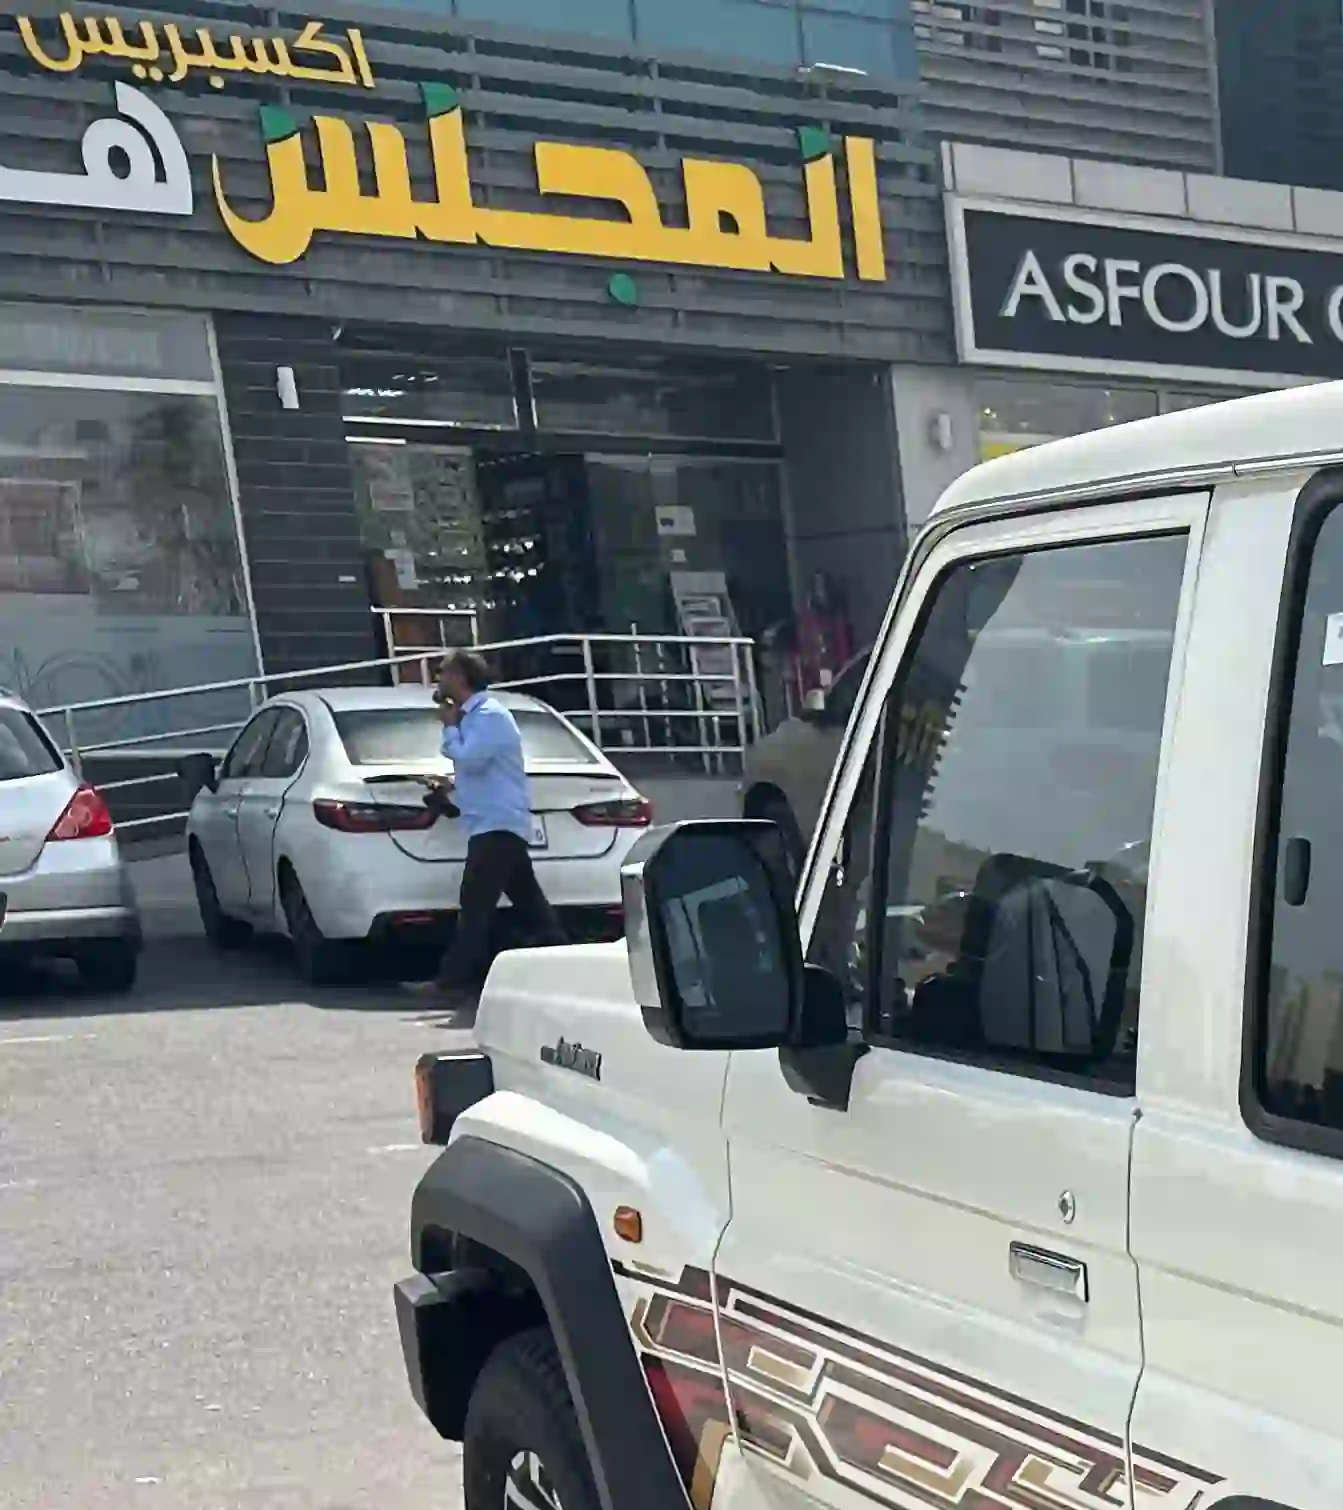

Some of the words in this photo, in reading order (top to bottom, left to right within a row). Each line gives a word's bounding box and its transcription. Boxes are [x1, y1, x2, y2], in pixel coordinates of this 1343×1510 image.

[15, 11, 376, 89] اكسبريس
[211, 81, 888, 306] المجلس
[1001, 248, 1314, 346] ASFOUR
